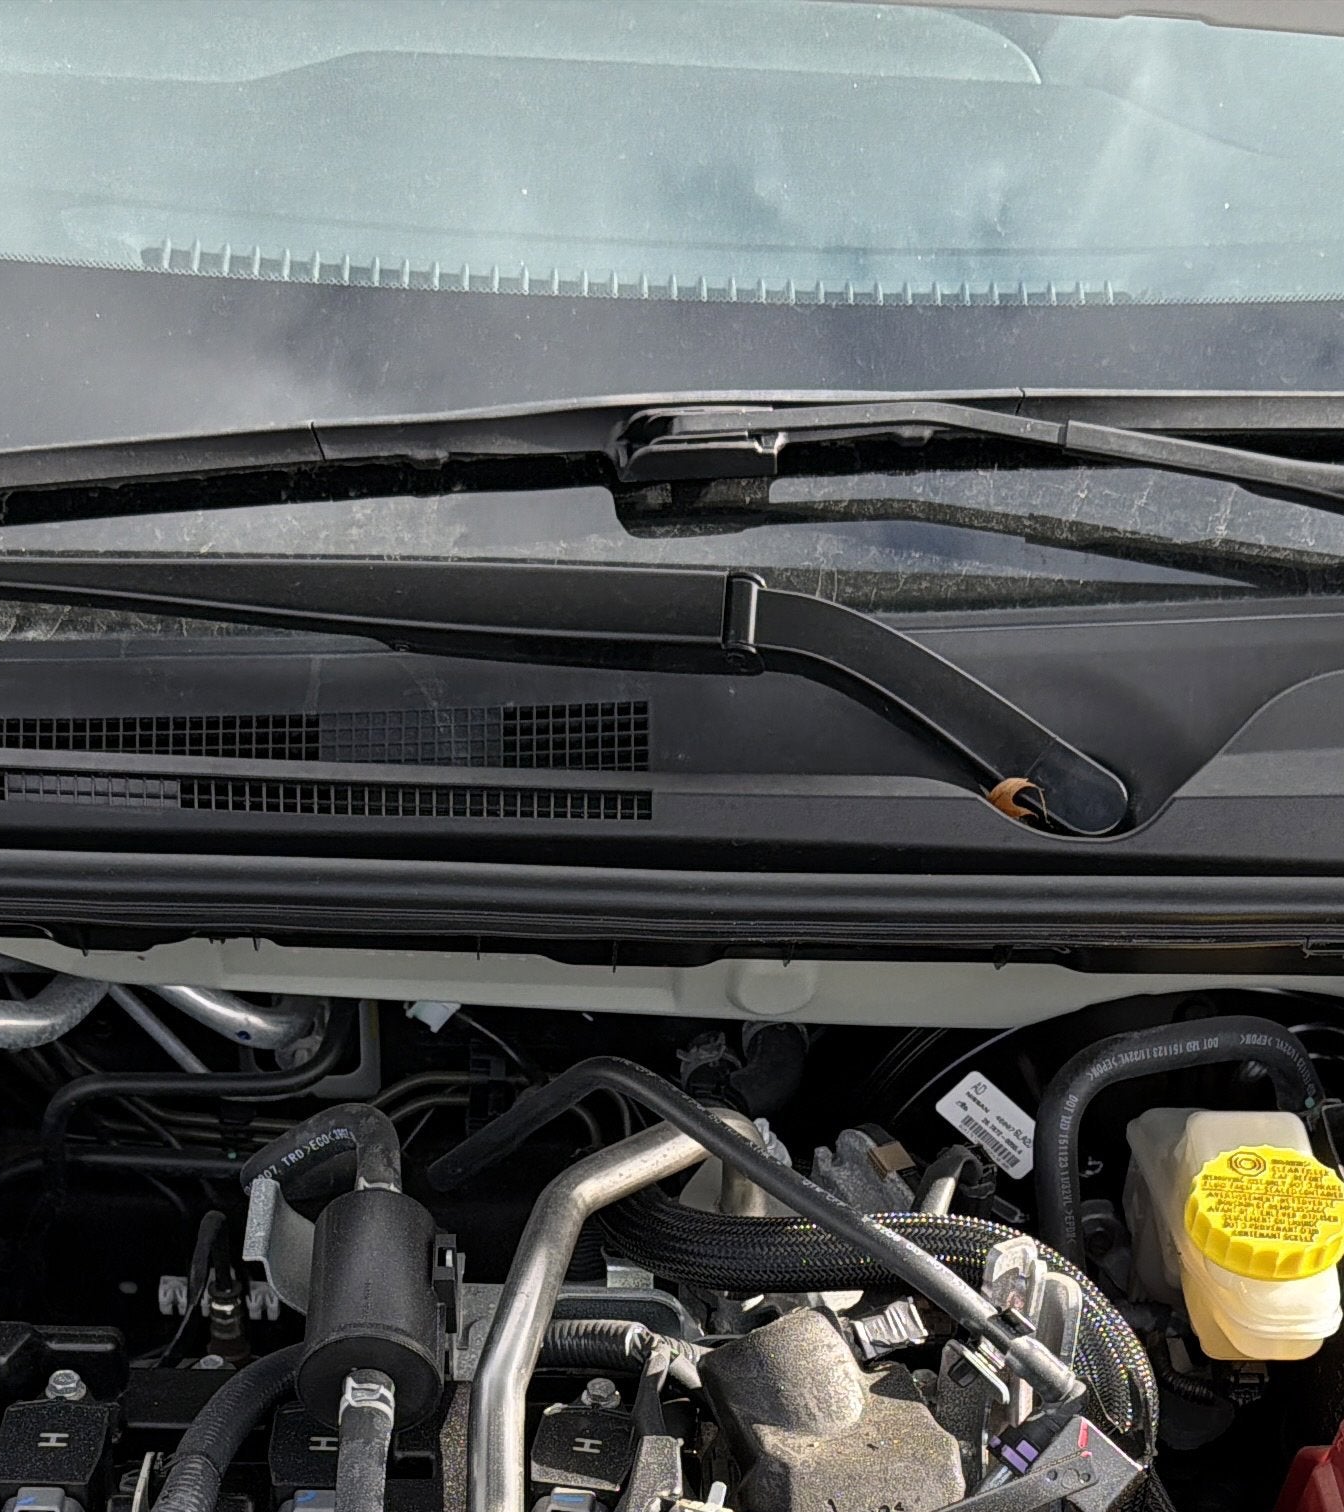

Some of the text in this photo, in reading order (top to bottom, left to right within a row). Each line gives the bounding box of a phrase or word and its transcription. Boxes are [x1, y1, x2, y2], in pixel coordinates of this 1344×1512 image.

[965, 1091, 990, 1113] NISSAN
[1064, 1094, 1078, 1115] DOT
[1058, 1135, 1071, 1168] 151123
